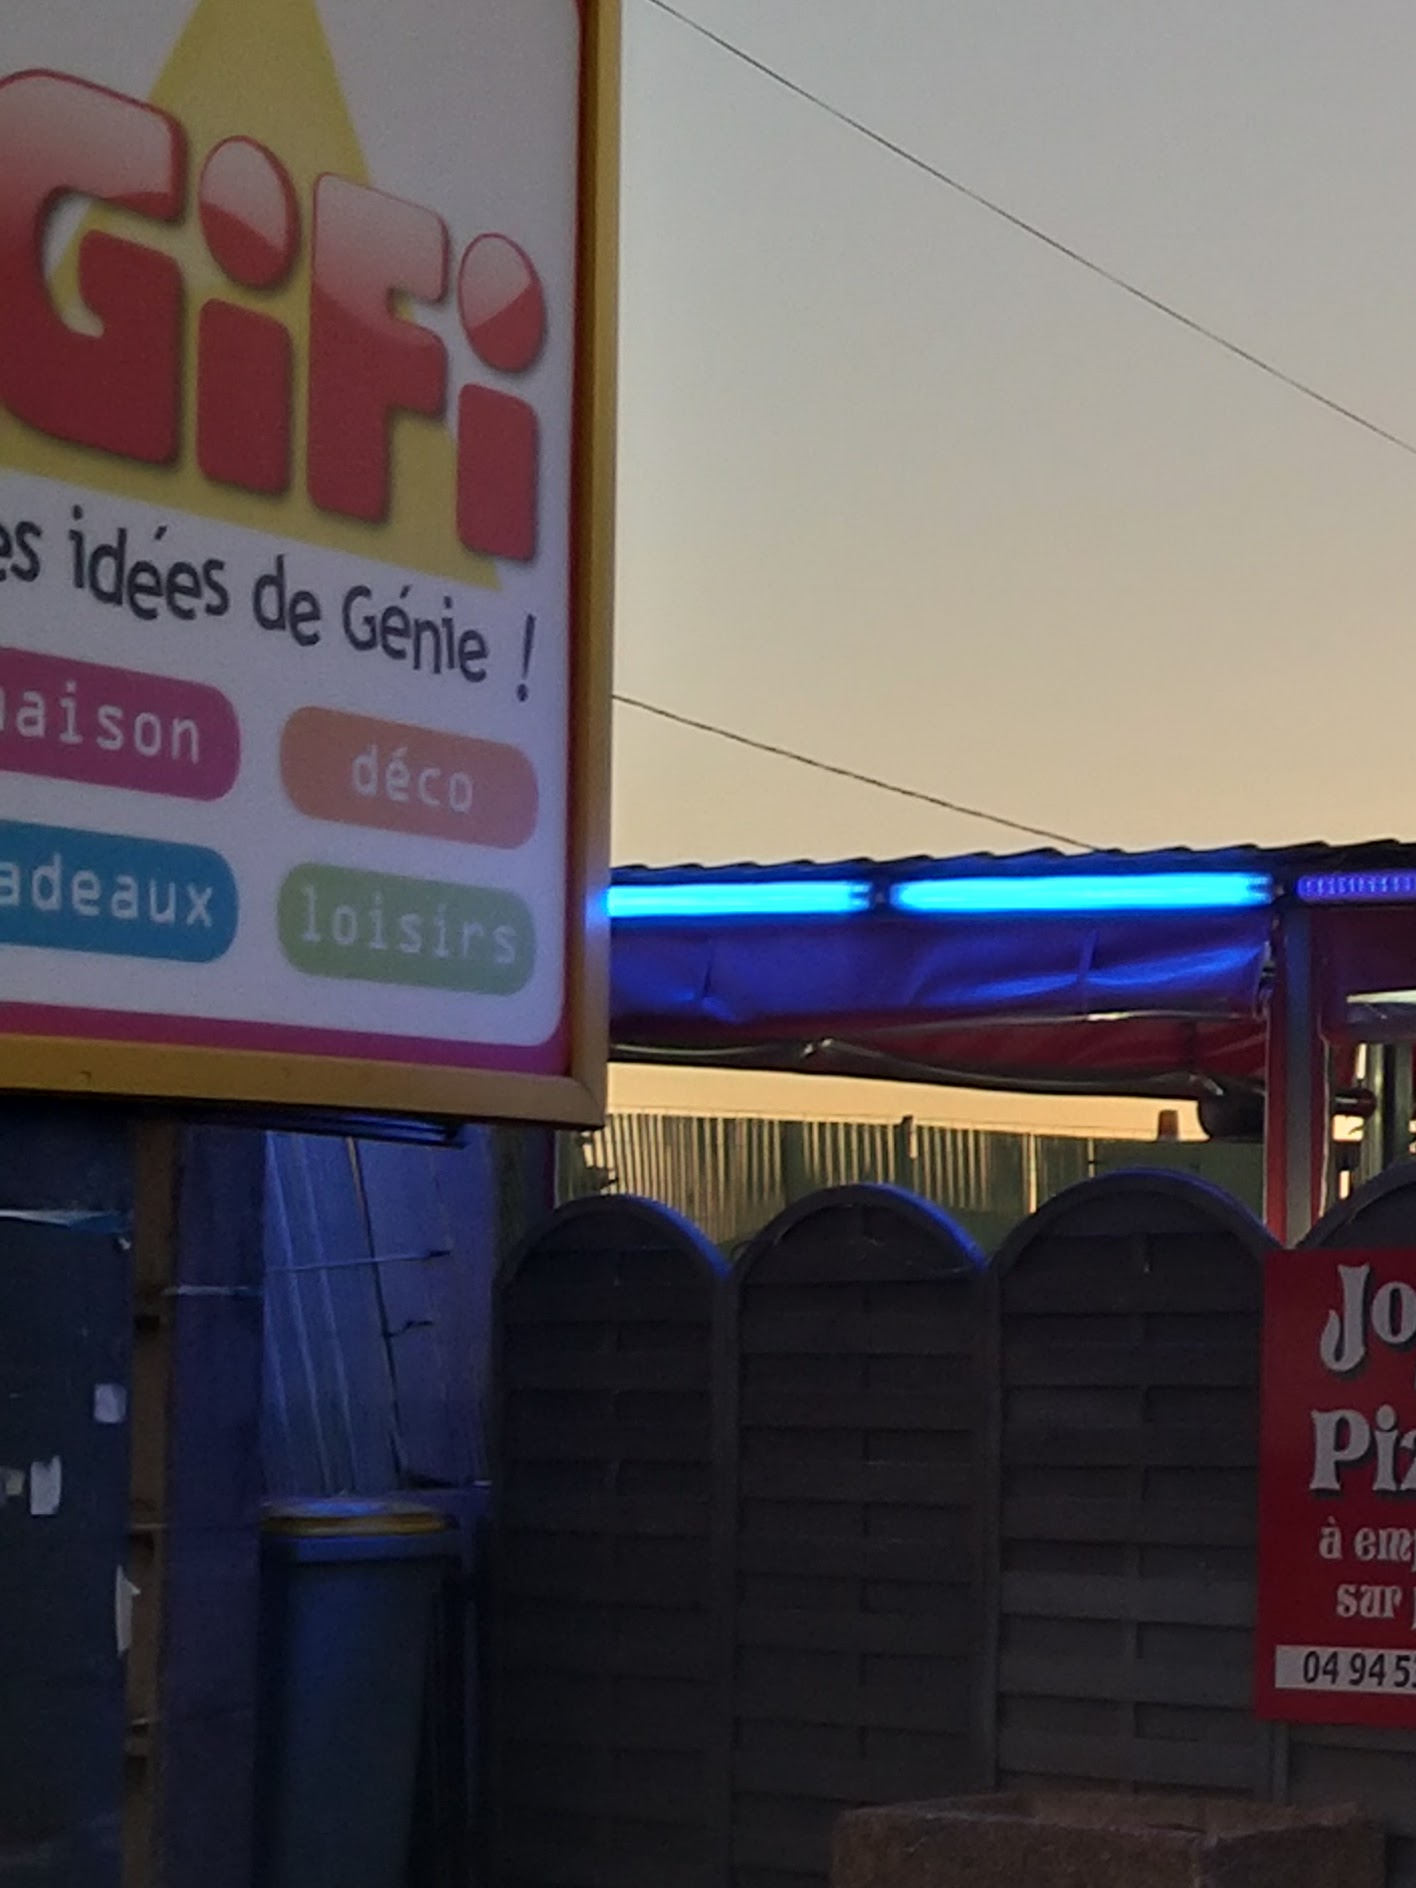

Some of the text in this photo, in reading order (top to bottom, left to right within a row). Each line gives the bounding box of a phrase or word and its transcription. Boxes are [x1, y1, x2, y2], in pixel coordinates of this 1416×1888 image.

[0, 69, 548, 562] GiFi
[70, 505, 230, 619] idées
[252, 553, 321, 646] de
[343, 585, 488, 682] Génie
[351, 743, 474, 814] déco
[300, 885, 517, 965] loisirs
[1318, 1516, 1343, 1561] à
[1336, 1582, 1402, 1619] sur
[1303, 1651, 1340, 1686] 04
[1349, 1652, 1388, 1688] 94
